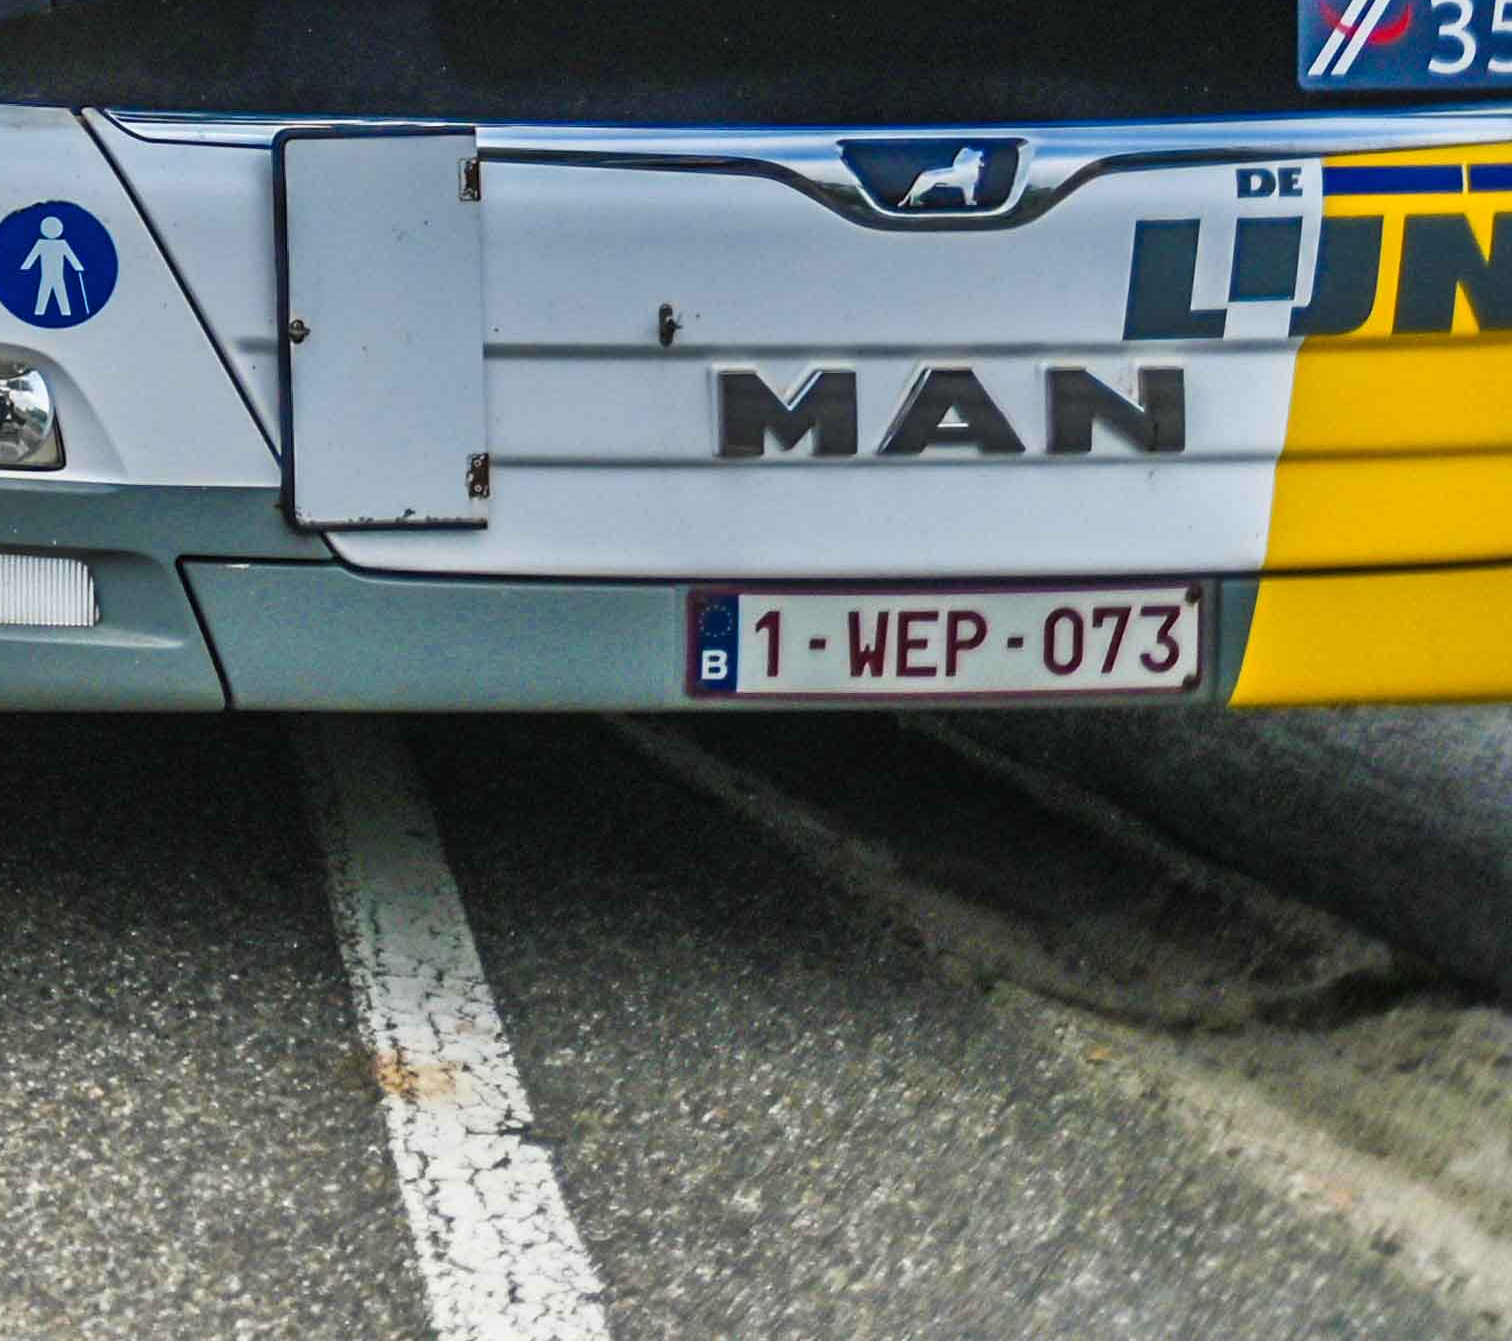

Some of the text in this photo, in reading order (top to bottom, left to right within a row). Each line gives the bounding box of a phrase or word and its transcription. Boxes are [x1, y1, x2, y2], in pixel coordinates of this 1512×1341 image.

[1235, 167, 1303, 199] DE
[716, 365, 1186, 458] MAN
[700, 605, 1183, 681] B 1-WEP-073
